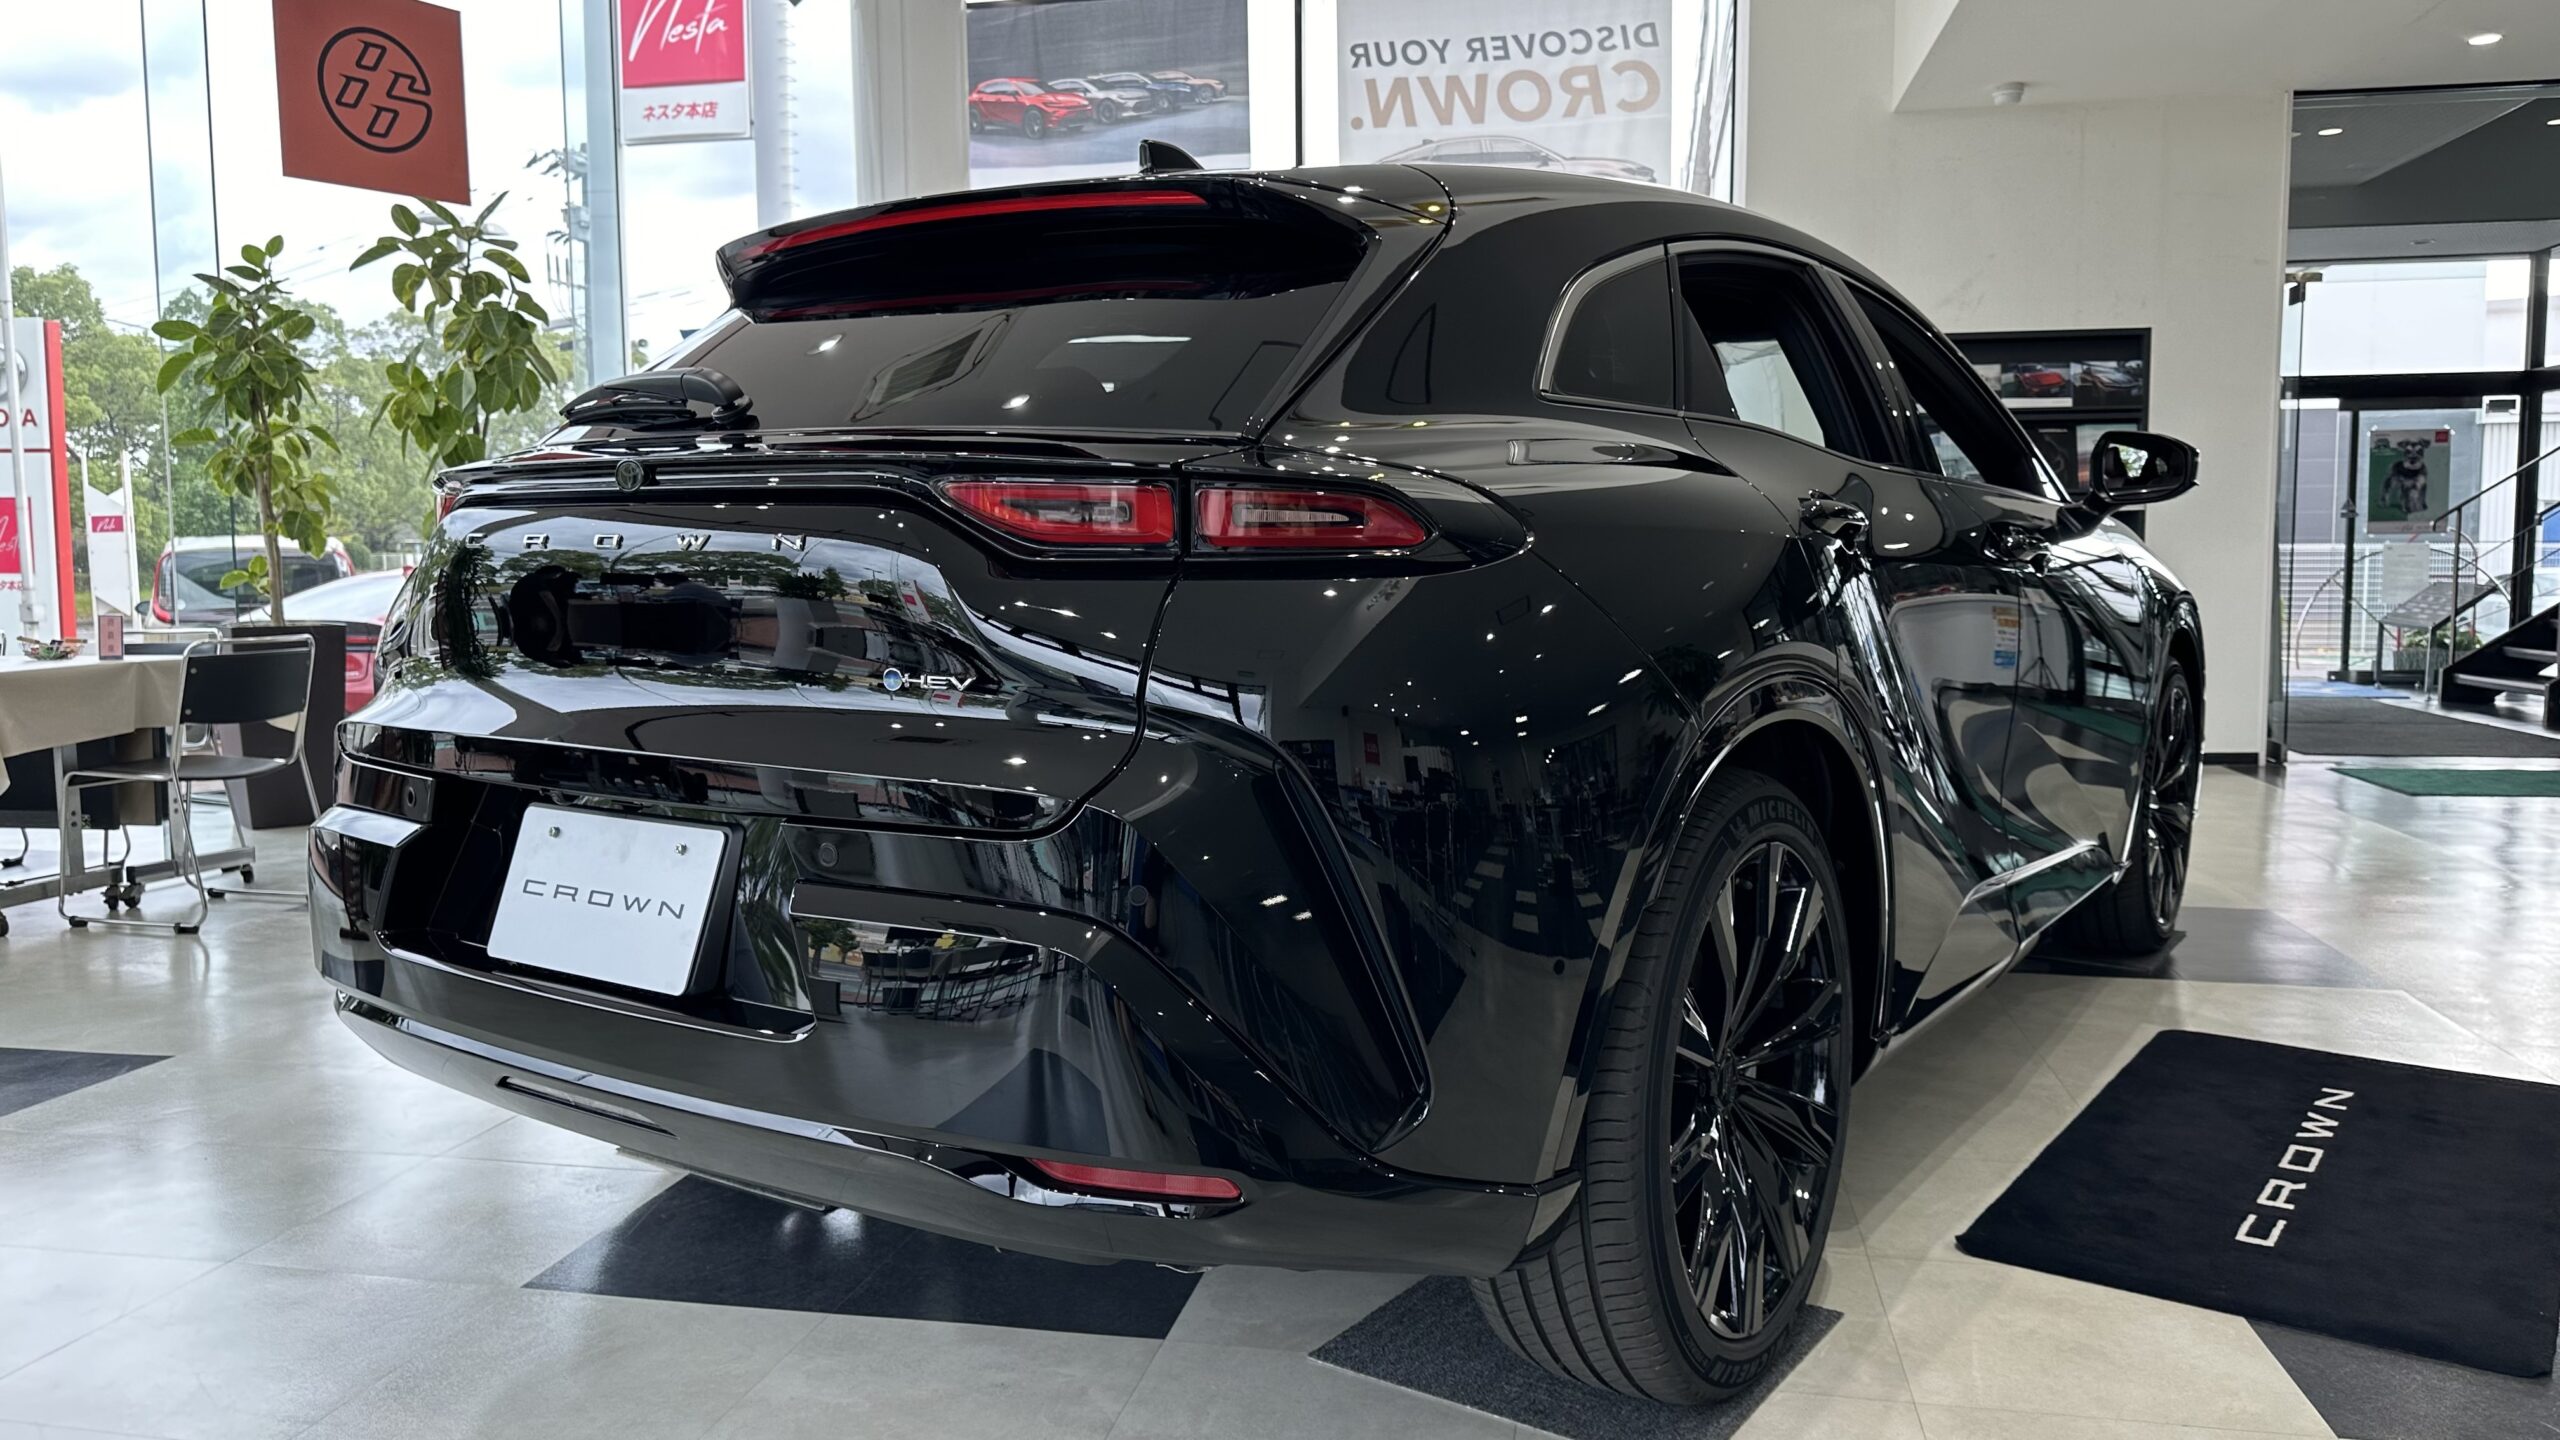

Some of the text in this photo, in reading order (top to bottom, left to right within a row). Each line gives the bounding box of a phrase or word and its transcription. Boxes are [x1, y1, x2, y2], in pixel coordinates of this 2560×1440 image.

[628, 0, 728, 62] Nesta
[643, 101, 718, 121] ネスタ本店
[465, 532, 807, 551] CROWN
[1747, 799, 1817, 842] MICHELIN
[522, 879, 686, 920] CROWN
[2235, 1087, 2355, 1247] CROWN
